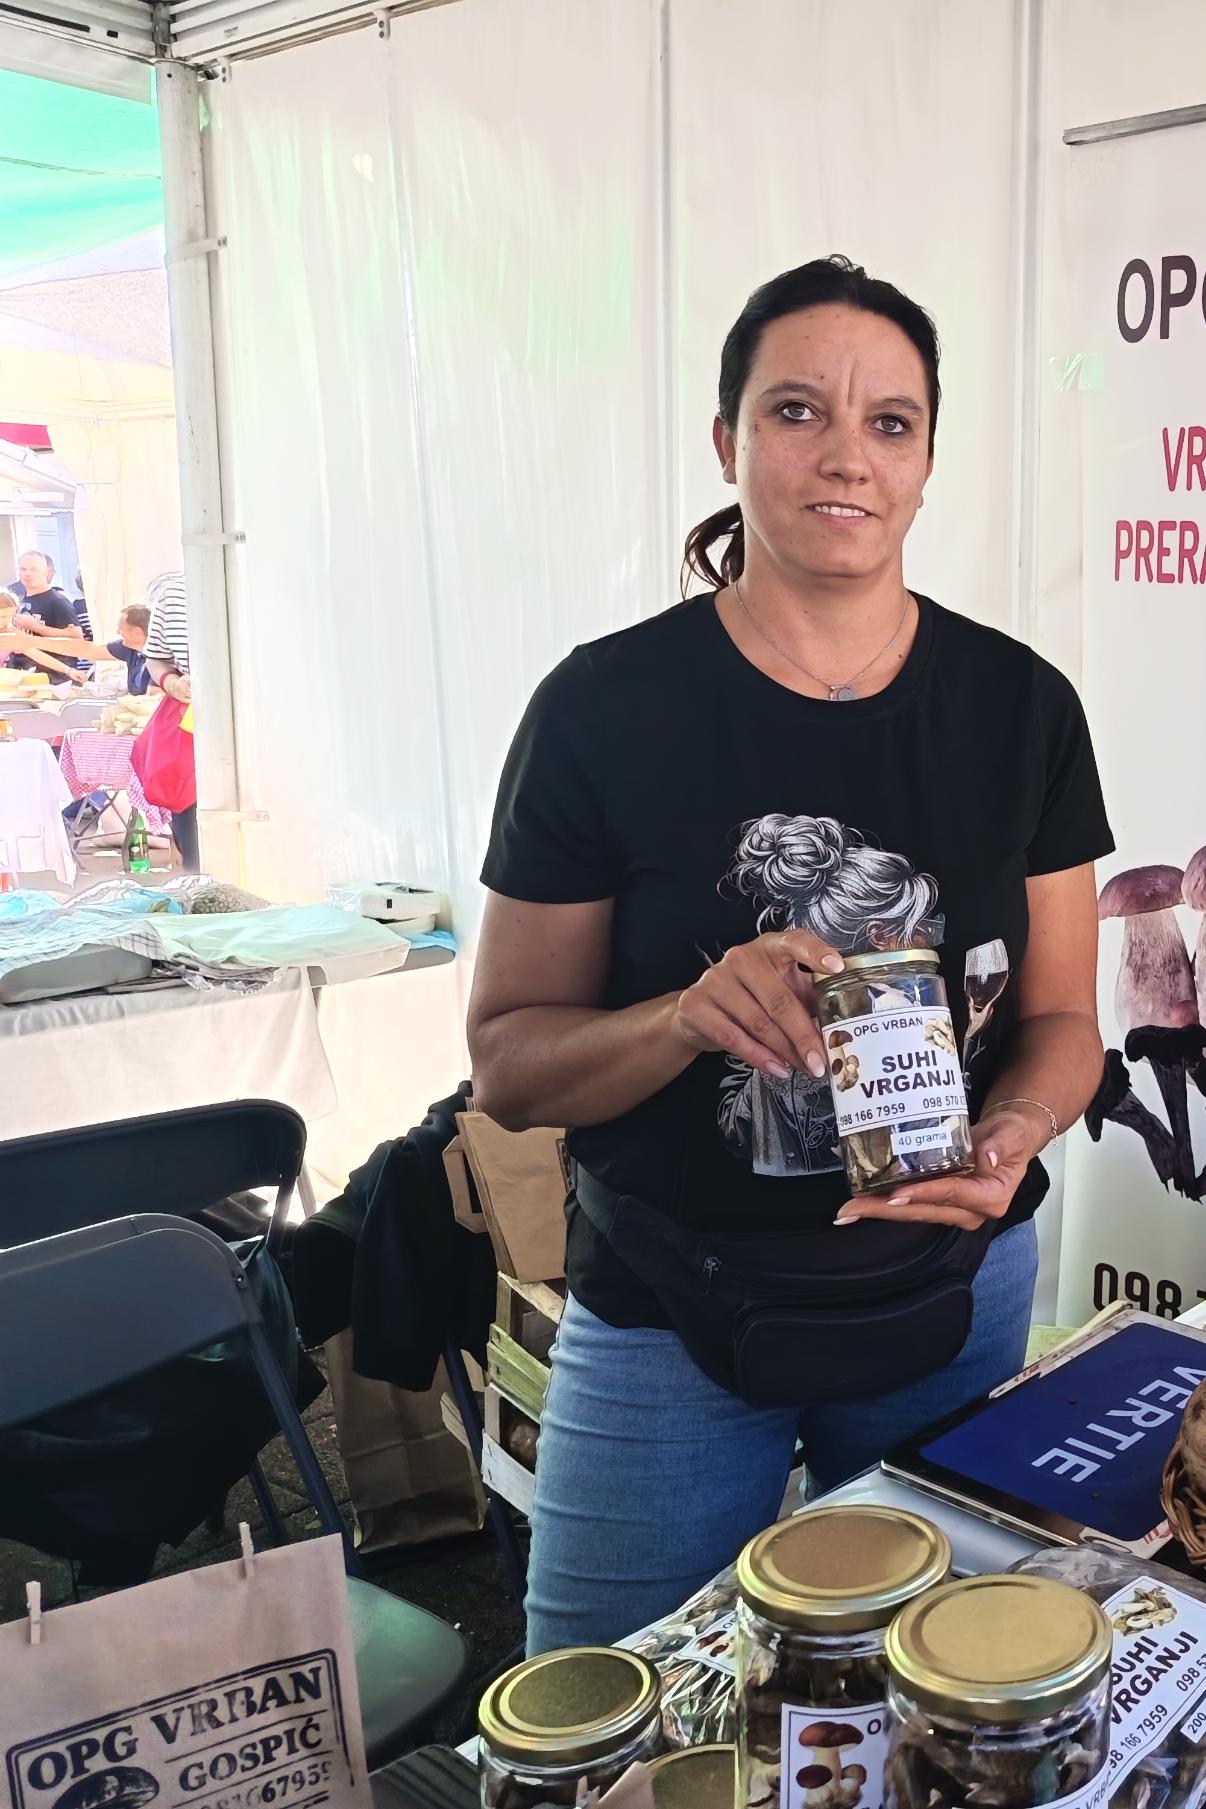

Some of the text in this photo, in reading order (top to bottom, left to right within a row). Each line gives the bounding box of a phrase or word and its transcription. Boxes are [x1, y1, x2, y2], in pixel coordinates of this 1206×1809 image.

[853, 1016, 924, 1037] OPG VRBAN
[881, 1050, 938, 1074] SUHI
[860, 1069, 956, 1099] VRGANJI
[855, 1109, 873, 1122] 166
[876, 1102, 906, 1116] 7959
[922, 1097, 942, 1109] 098
[945, 1095, 959, 1106] 570
[899, 1132, 948, 1146] 40 grama
[1093, 1262, 1182, 1321] 098
[1111, 1635, 1159, 1686] SUHI
[1111, 1631, 1199, 1725] VRGANJI
[28, 1666, 322, 1791] OPG VRBAN
[1110, 1749, 1124, 1769] 98
[1120, 1733, 1141, 1751] 166
[1137, 1704, 1168, 1737] 7959
[1176, 1666, 1200, 1692] 098
[1187, 1712, 1206, 1735] 200
[179, 1717, 323, 1792] GOSPIĆ
